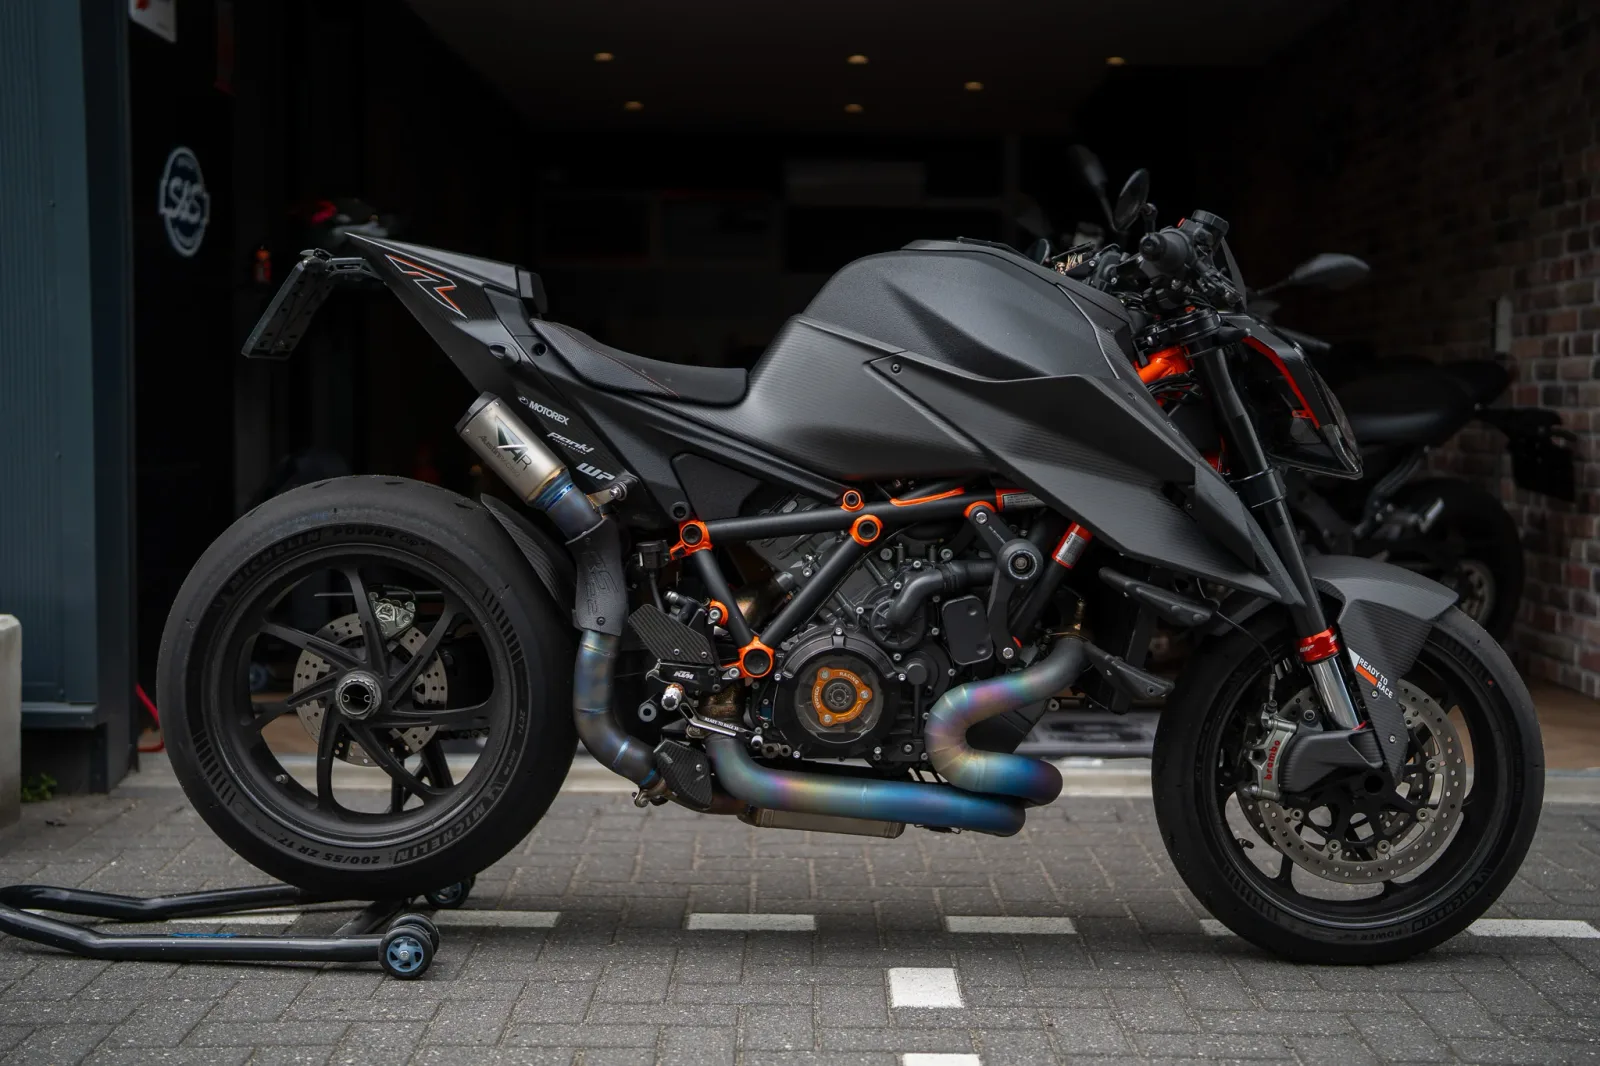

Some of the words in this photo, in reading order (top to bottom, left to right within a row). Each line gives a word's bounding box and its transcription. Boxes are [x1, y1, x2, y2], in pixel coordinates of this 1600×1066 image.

[529, 401, 570, 425] MOTOREX
[576, 462, 615, 481] WP
[231, 527, 322, 593] MICHELIN
[332, 526, 395, 539] POWER
[673, 670, 694, 679] KTM
[839, 671, 860, 685] RACING
[1358, 658, 1381, 678] READY
[1379, 674, 1388, 686] TO
[1376, 681, 1394, 699] RACE
[1264, 740, 1281, 781] brembo
[393, 802, 486, 865] MICHELIN
[277, 837, 293, 850] 17
[297, 844, 321, 857] ZR
[322, 852, 380, 865] 200/55
